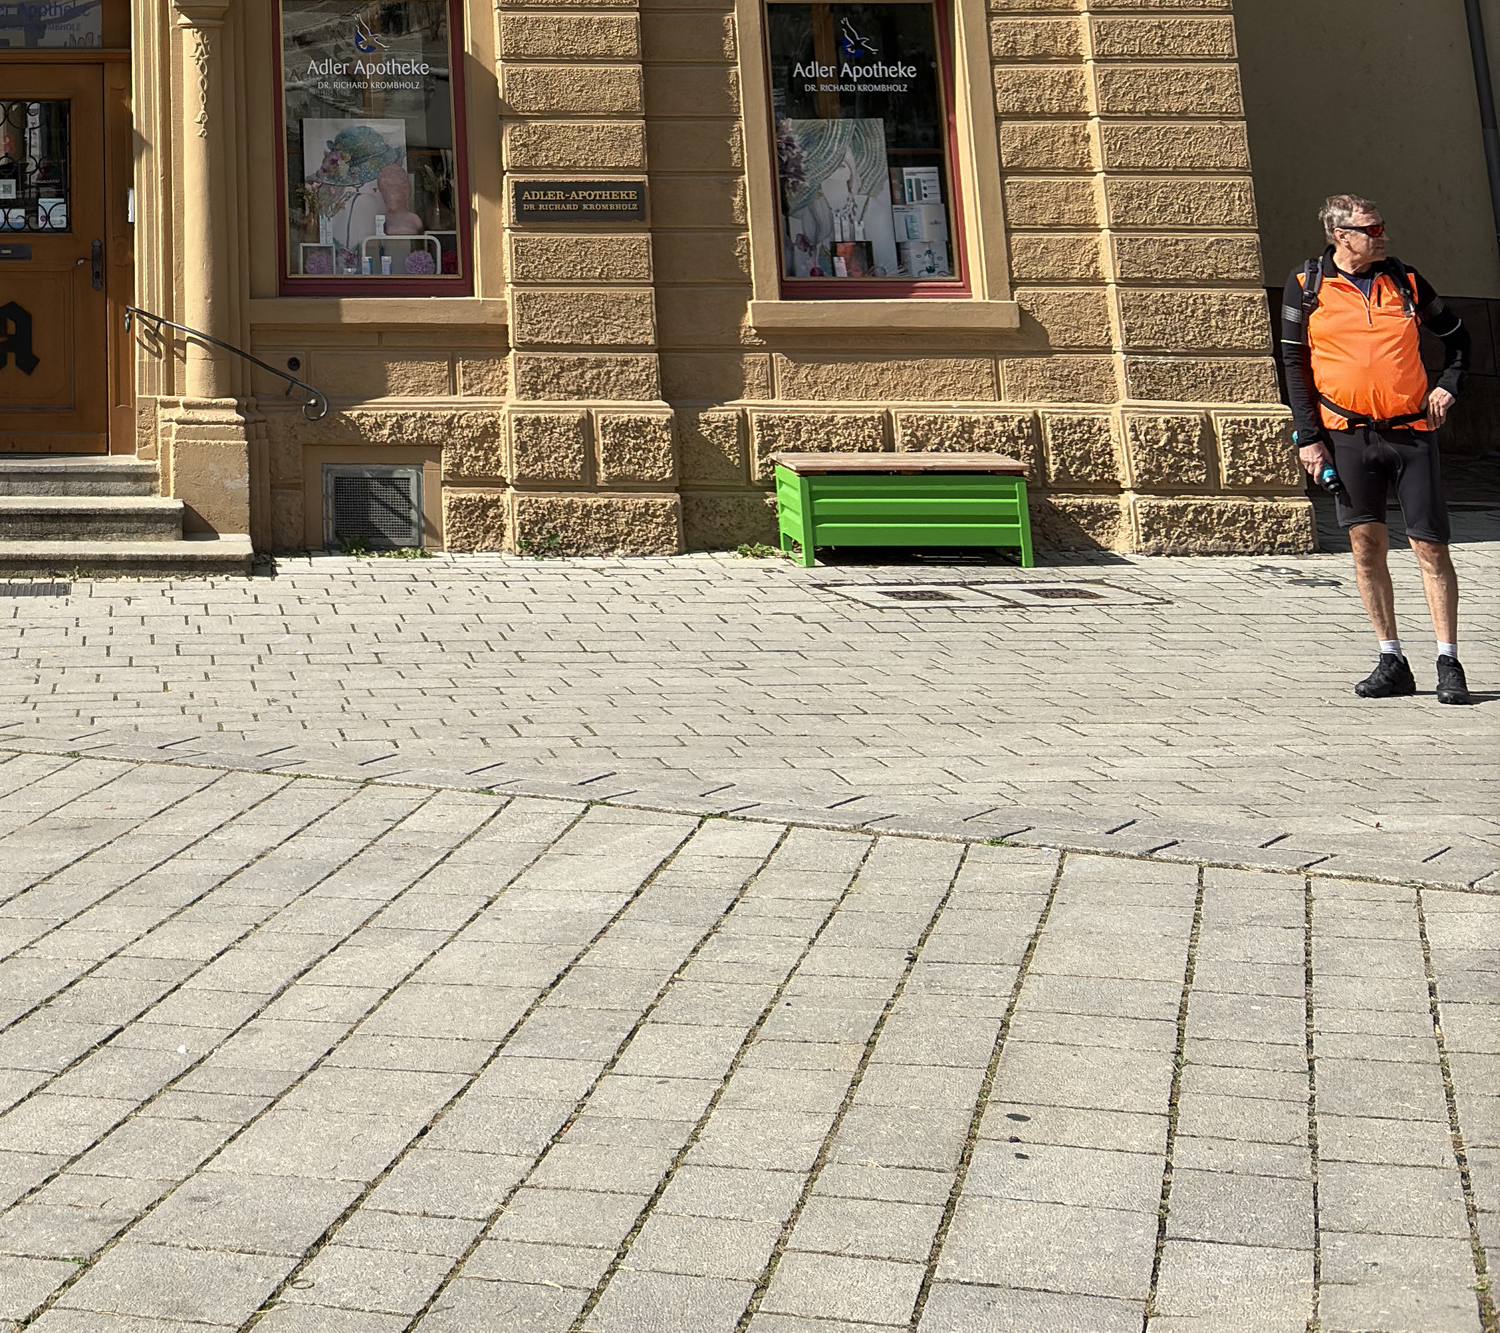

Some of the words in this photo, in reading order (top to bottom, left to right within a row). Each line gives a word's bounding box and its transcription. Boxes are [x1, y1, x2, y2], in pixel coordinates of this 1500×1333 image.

[306, 58, 350, 75] Adler
[353, 58, 430, 79] Apotheke
[792, 61, 837, 78] Adler
[840, 61, 917, 82] Apotheke
[317, 81, 331, 89] DR.
[333, 81, 368, 89] RICHARD
[370, 81, 420, 89] KROMBHOLZ
[804, 84, 818, 92] DR.
[820, 84, 856, 92] RICHARD
[857, 84, 908, 92] KROMBHOLZ
[521, 190, 638, 200] ADLER-APOTHEKE
[523, 203, 535, 211] DR
[538, 203, 579, 211] RICHARD
[582, 203, 638, 211] KROMBHOLZ
